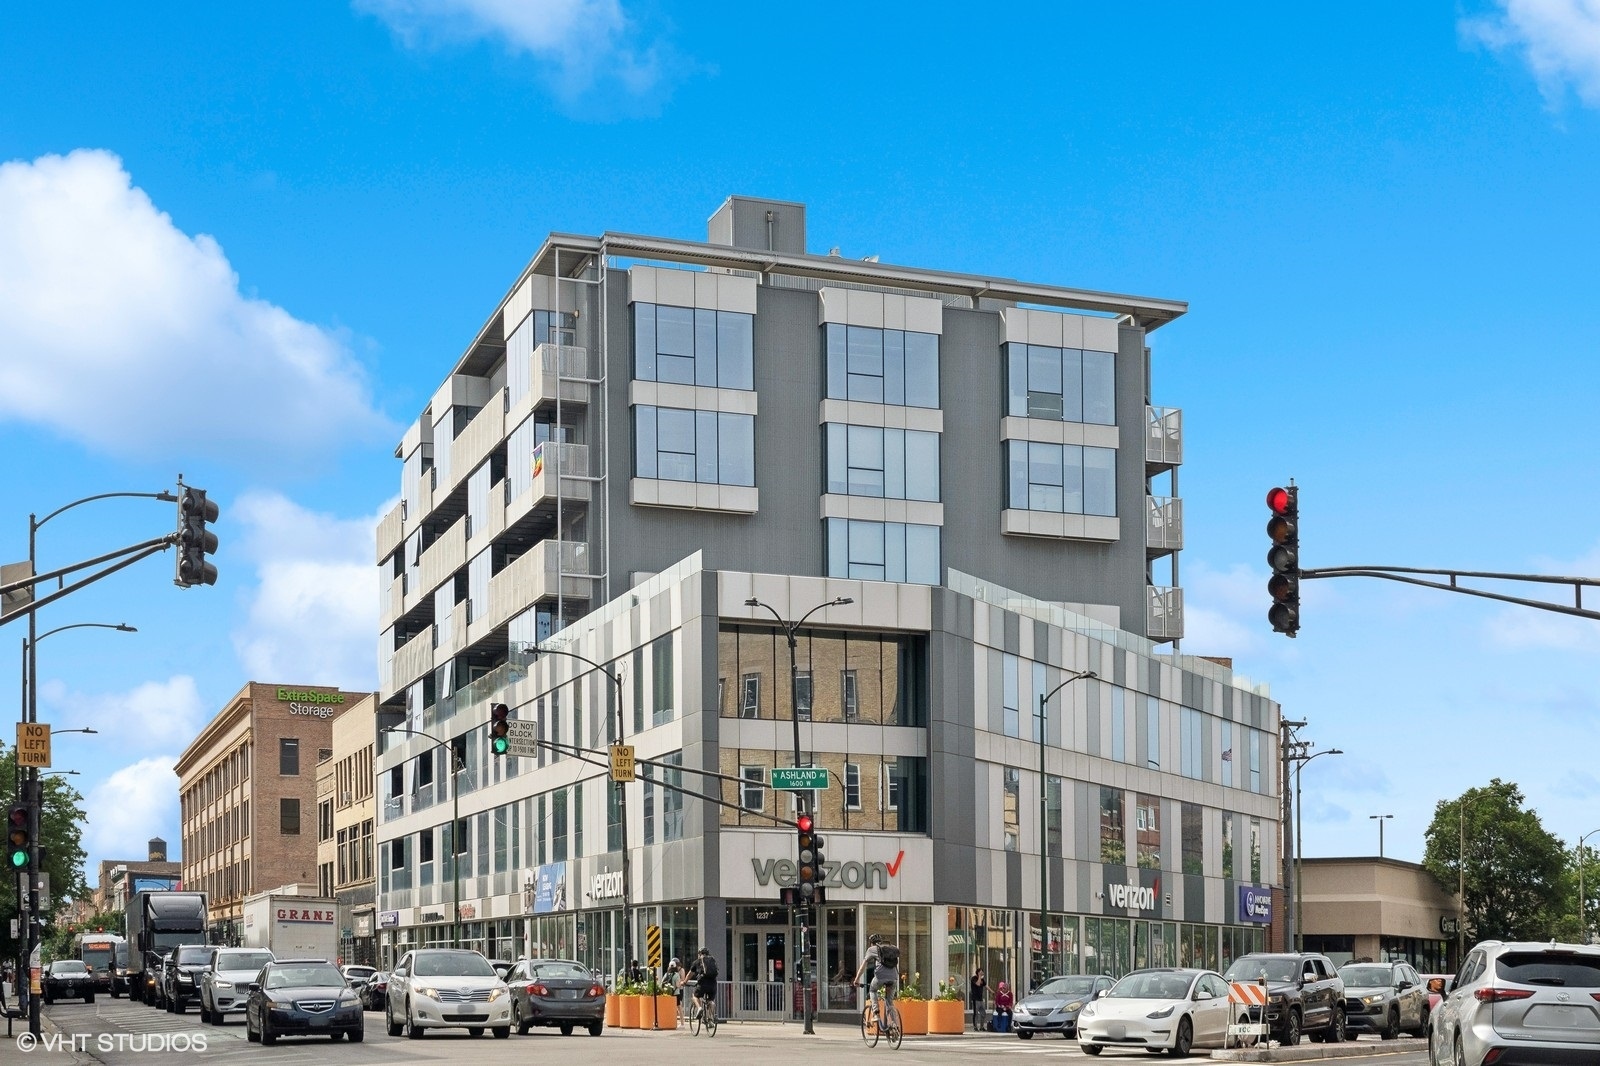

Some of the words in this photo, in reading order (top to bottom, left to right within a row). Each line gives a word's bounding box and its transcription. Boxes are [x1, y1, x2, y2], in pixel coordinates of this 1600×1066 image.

[290, 702, 334, 718] Storage
[26, 727, 43, 737] NO
[510, 730, 532, 738] BLOCK
[24, 740, 46, 750] LEFT
[22, 752, 47, 763] TURN
[616, 748, 629, 757] NO
[616, 758, 631, 767] LEFT
[615, 769, 632, 778] TURN
[780, 771, 817, 779] ASHLAND
[751, 858, 888, 890] vezon
[592, 865, 624, 900] verizon
[1109, 878, 1155, 910] verizon
[277, 909, 334, 921] GRANE
[756, 912, 769, 920] 1237
